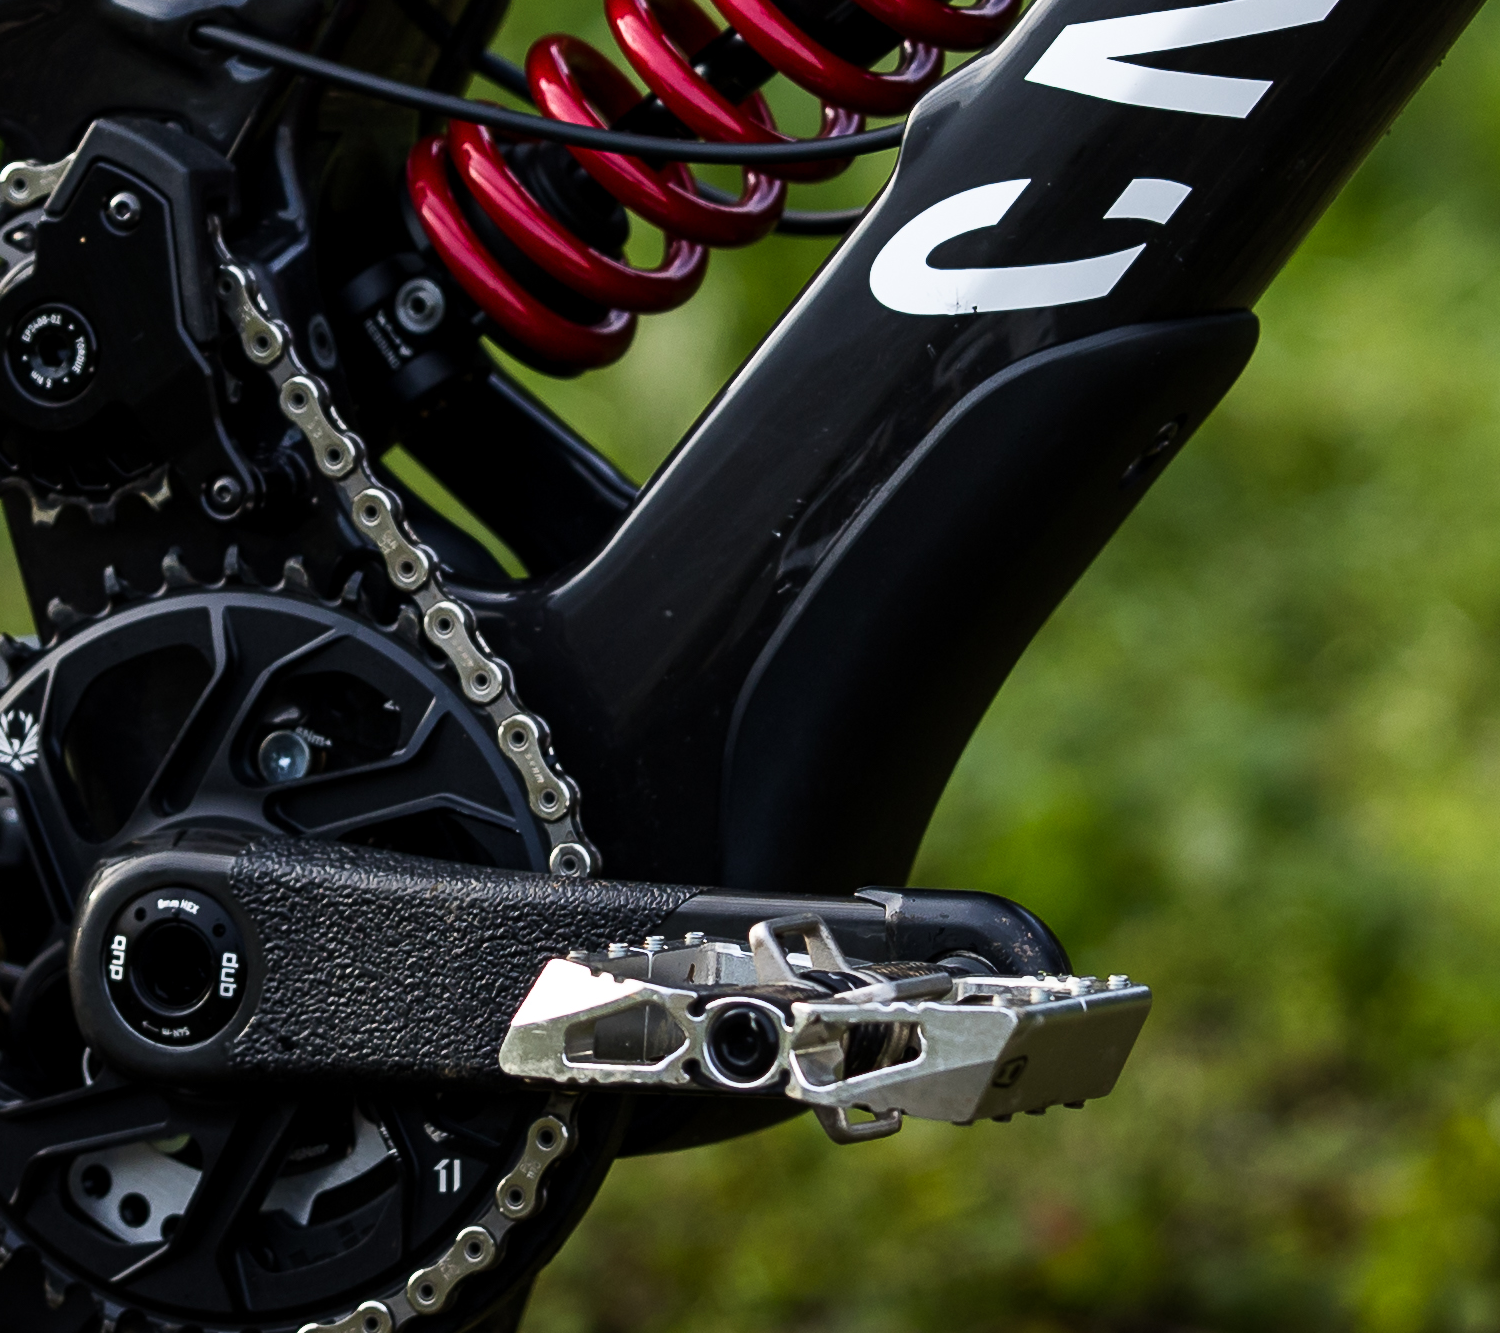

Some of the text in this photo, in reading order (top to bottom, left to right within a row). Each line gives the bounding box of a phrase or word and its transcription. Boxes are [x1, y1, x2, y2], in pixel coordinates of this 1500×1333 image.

[180, 898, 200, 915] HEX
[109, 935, 127, 981] dub
[219, 952, 239, 997] dub
